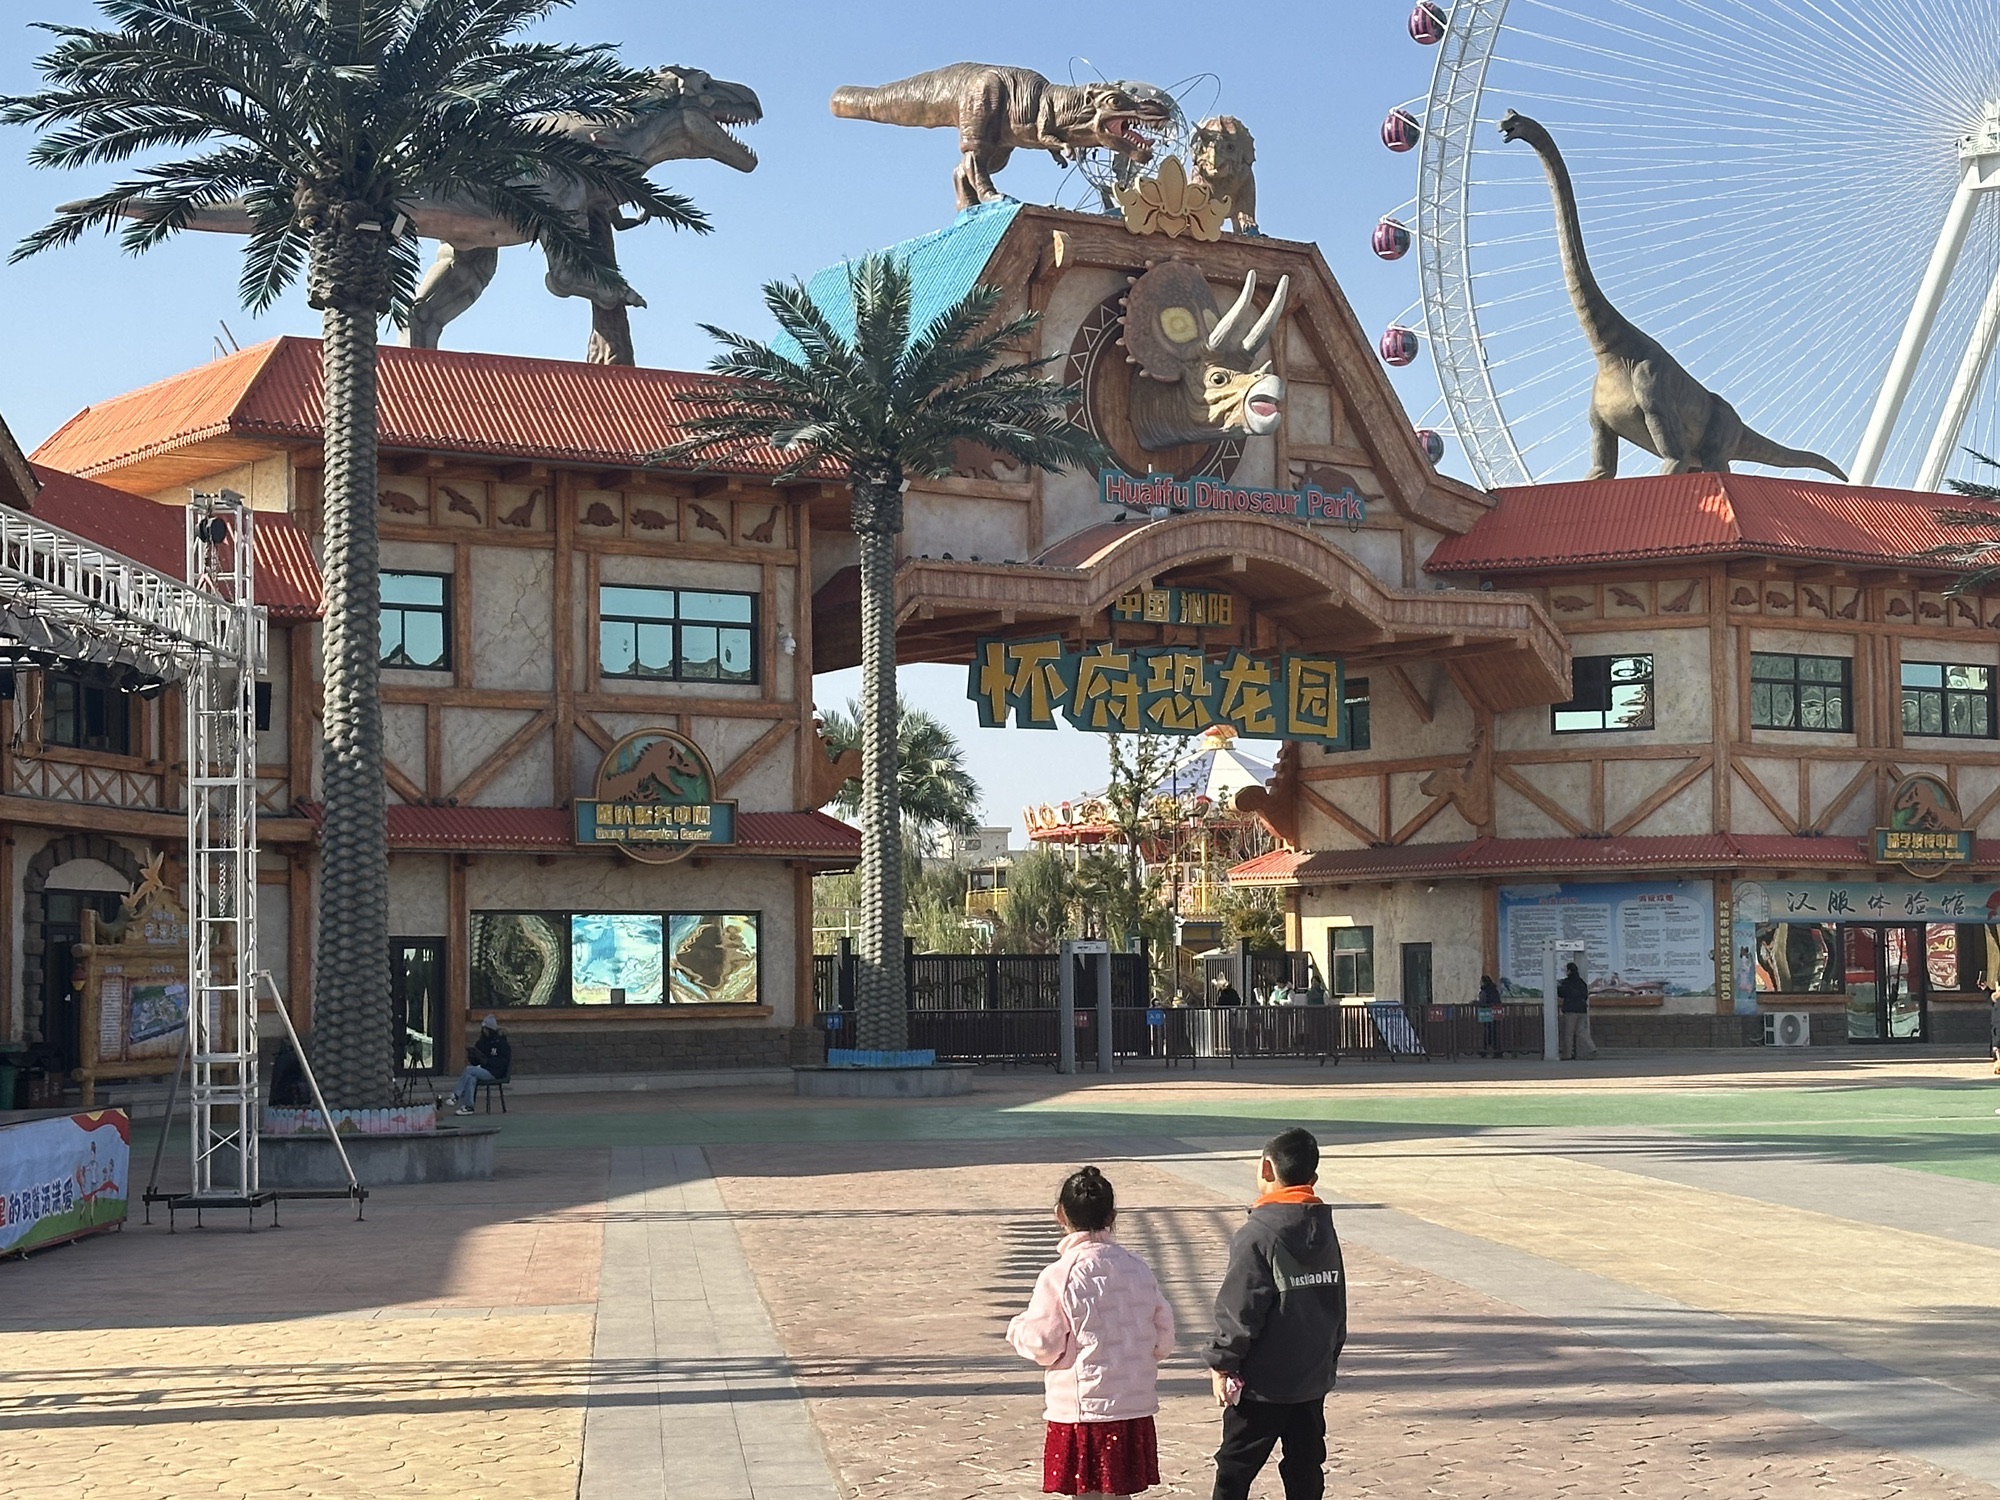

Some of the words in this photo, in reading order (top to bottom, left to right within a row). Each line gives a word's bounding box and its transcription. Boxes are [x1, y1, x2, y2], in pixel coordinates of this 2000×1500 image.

[1106, 475, 1189, 507] Huaifu
[1195, 481, 1300, 515] Dinosaur
[1307, 489, 1363, 520] Park
[1115, 589, 1170, 622] 中国
[1179, 591, 1232, 625] 沁阳
[980, 639, 1339, 739] 怀府恐龙园
[1786, 887, 1967, 917] 汉服体验馆
